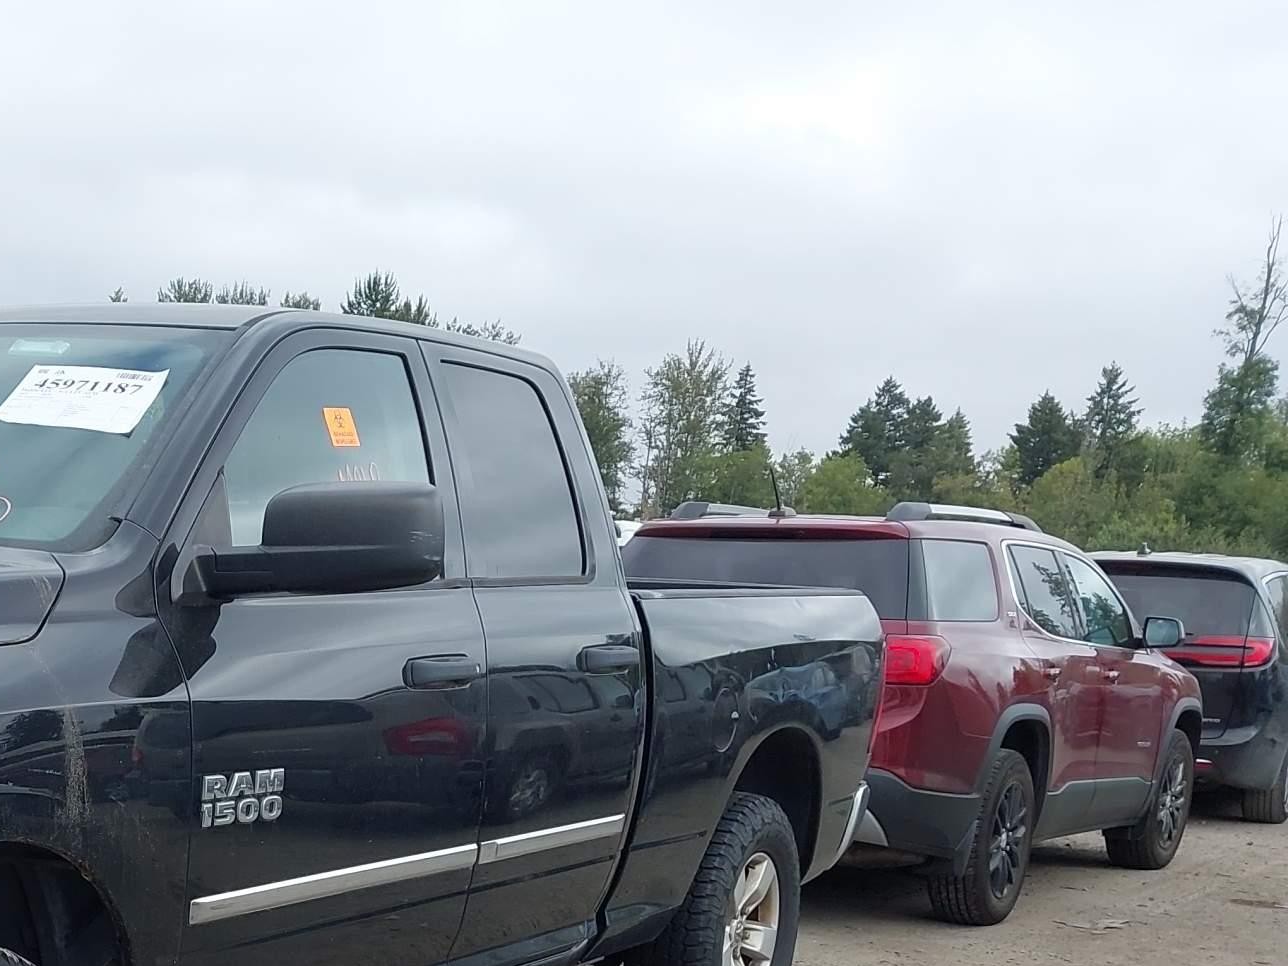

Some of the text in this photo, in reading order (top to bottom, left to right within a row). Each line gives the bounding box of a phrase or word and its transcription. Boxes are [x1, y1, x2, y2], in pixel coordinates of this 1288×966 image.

[34, 377, 144, 396] 45971187
[201, 768, 285, 800] RAM
[200, 795, 284, 828] 1500
